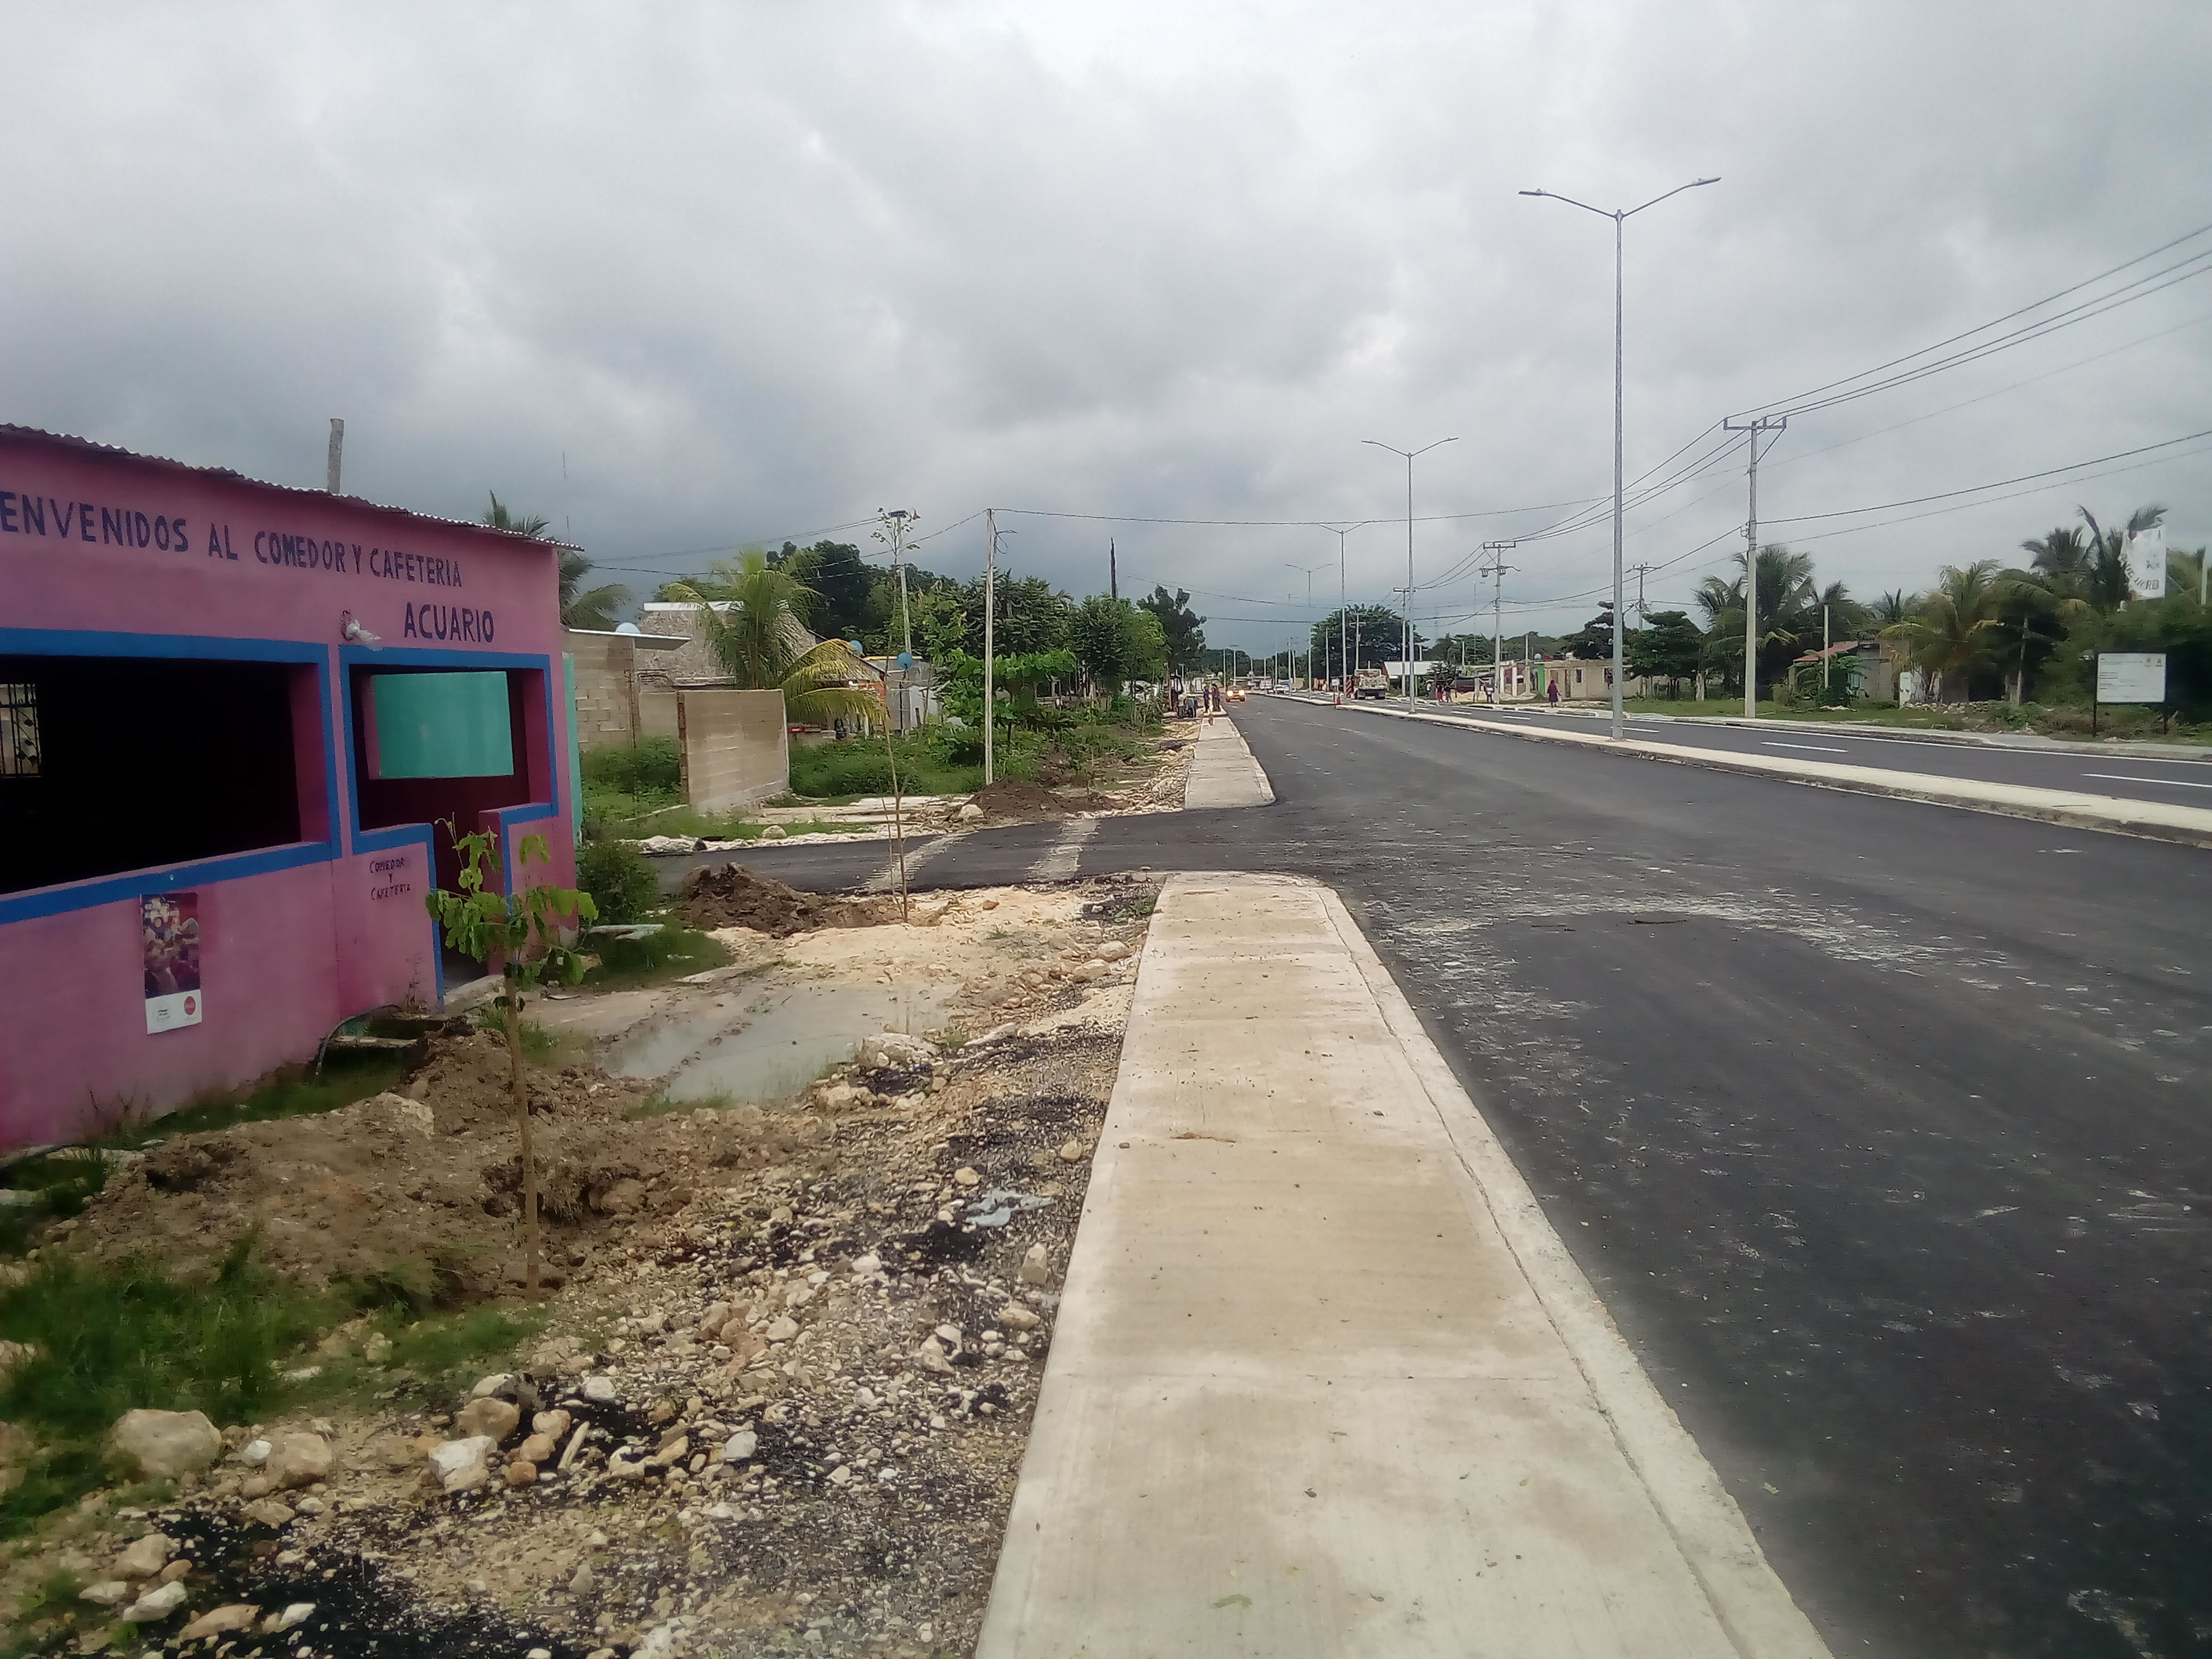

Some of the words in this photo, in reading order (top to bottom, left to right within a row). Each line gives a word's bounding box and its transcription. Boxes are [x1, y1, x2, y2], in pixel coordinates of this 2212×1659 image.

[0, 491, 189, 553] ENVENIDOS
[208, 522, 239, 560] AL
[255, 531, 346, 573] COMEDOR
[351, 543, 362, 574] Y
[370, 548, 462, 587] CAFETERIA
[404, 601, 495, 643] ACUARIO
[370, 857, 405, 873] COMEDOR
[388, 873, 393, 883] Y
[371, 883, 410, 900] CAFETERIA
